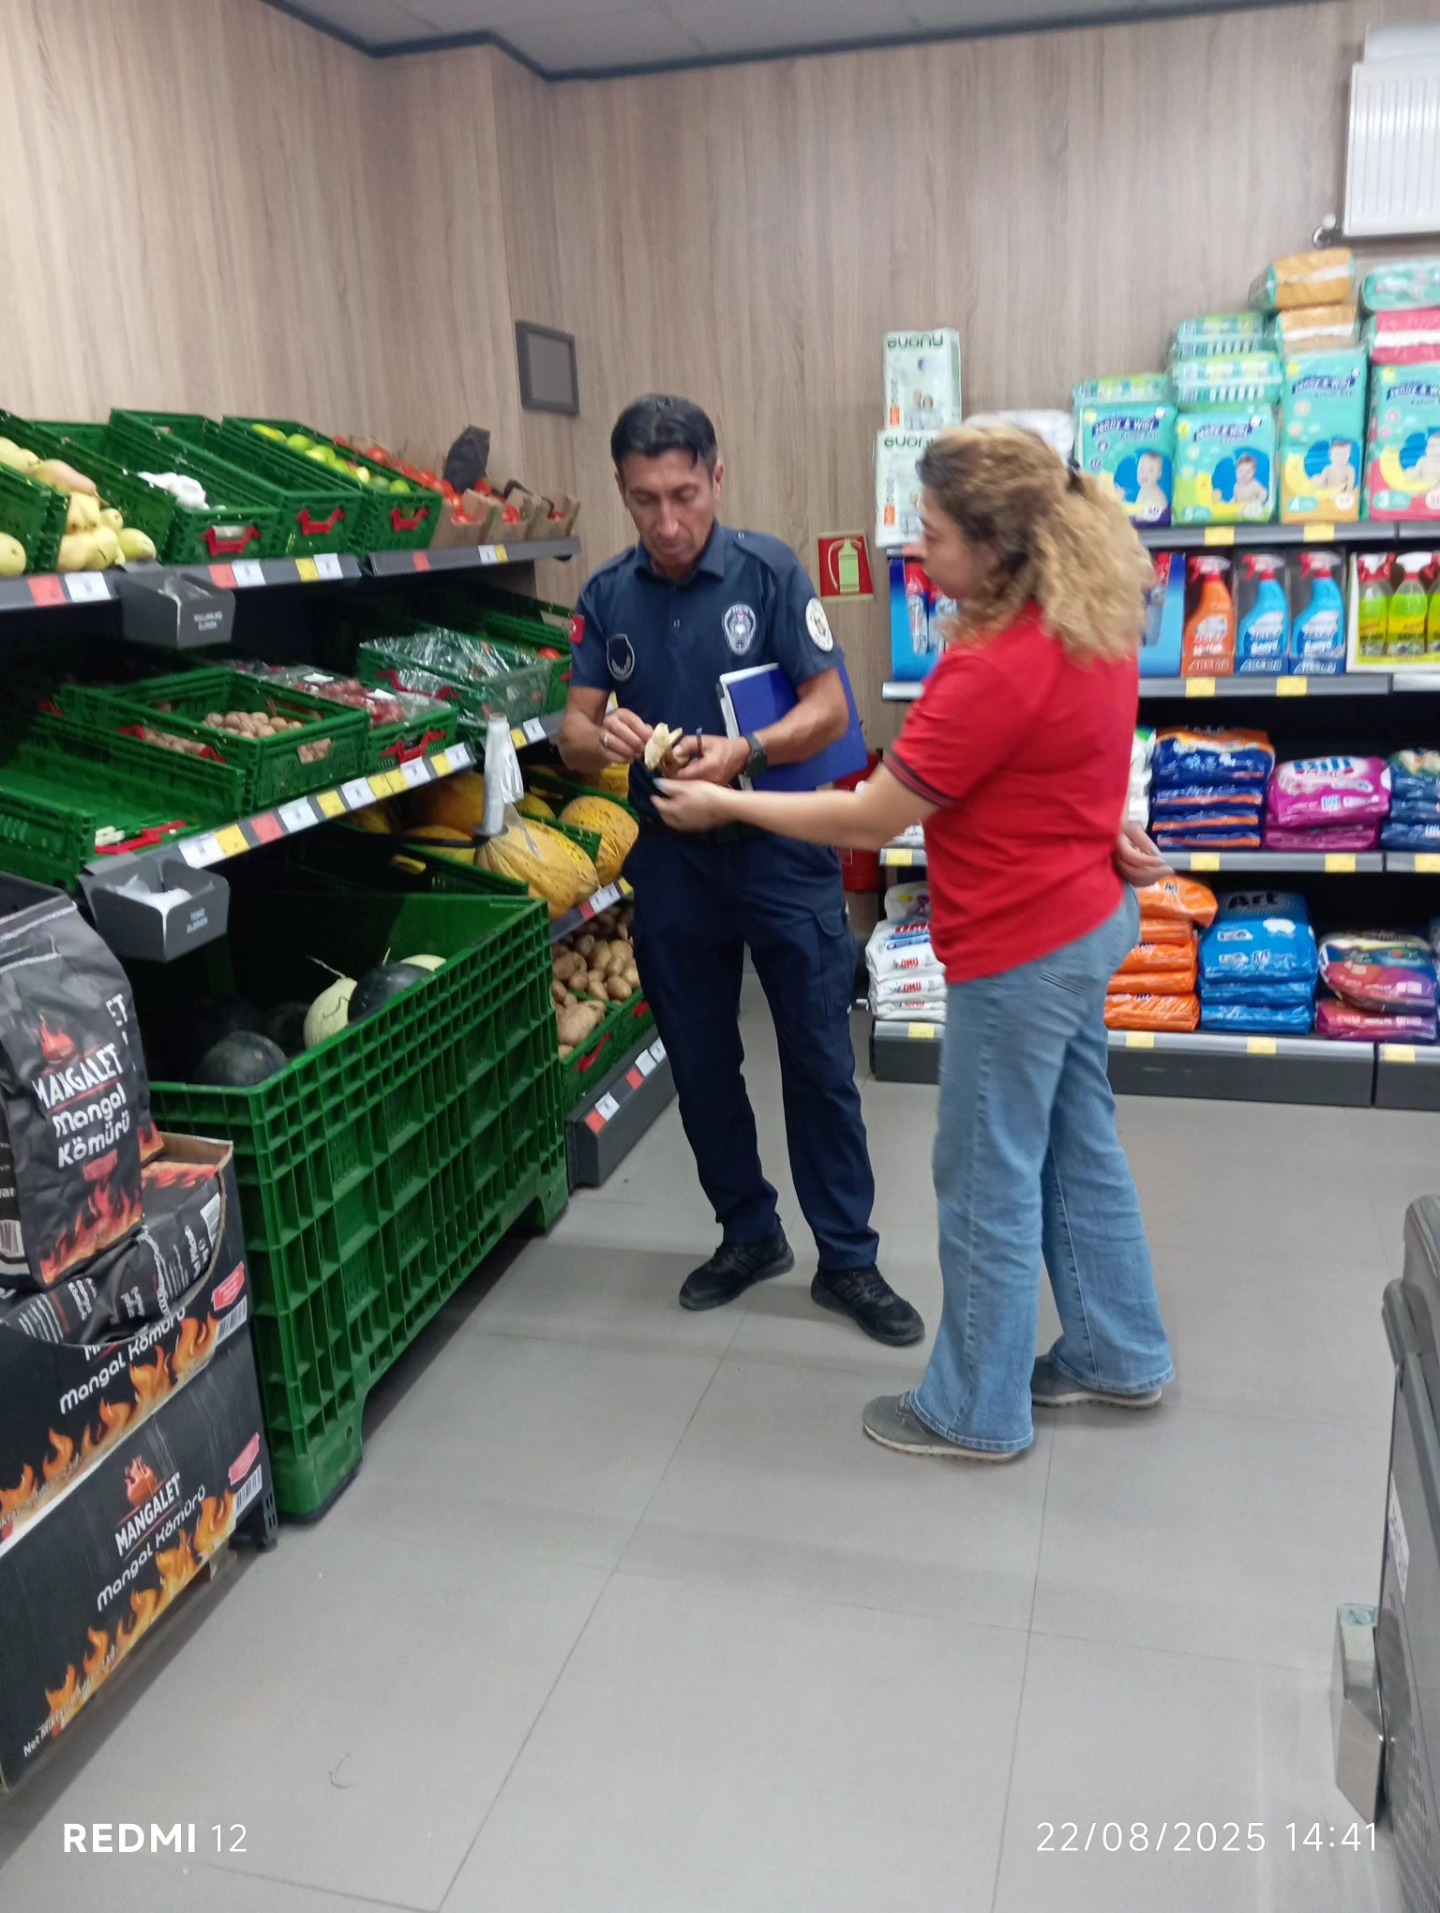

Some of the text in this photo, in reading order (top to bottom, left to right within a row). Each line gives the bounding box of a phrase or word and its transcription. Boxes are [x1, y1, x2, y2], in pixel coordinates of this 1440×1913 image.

[52, 1082, 127, 1138] Mangal
[58, 1110, 130, 1168] Kömürü
[60, 1351, 125, 1414] Mangal
[115, 1472, 180, 1557] MANGALET
[97, 1542, 153, 1612] Mangal
